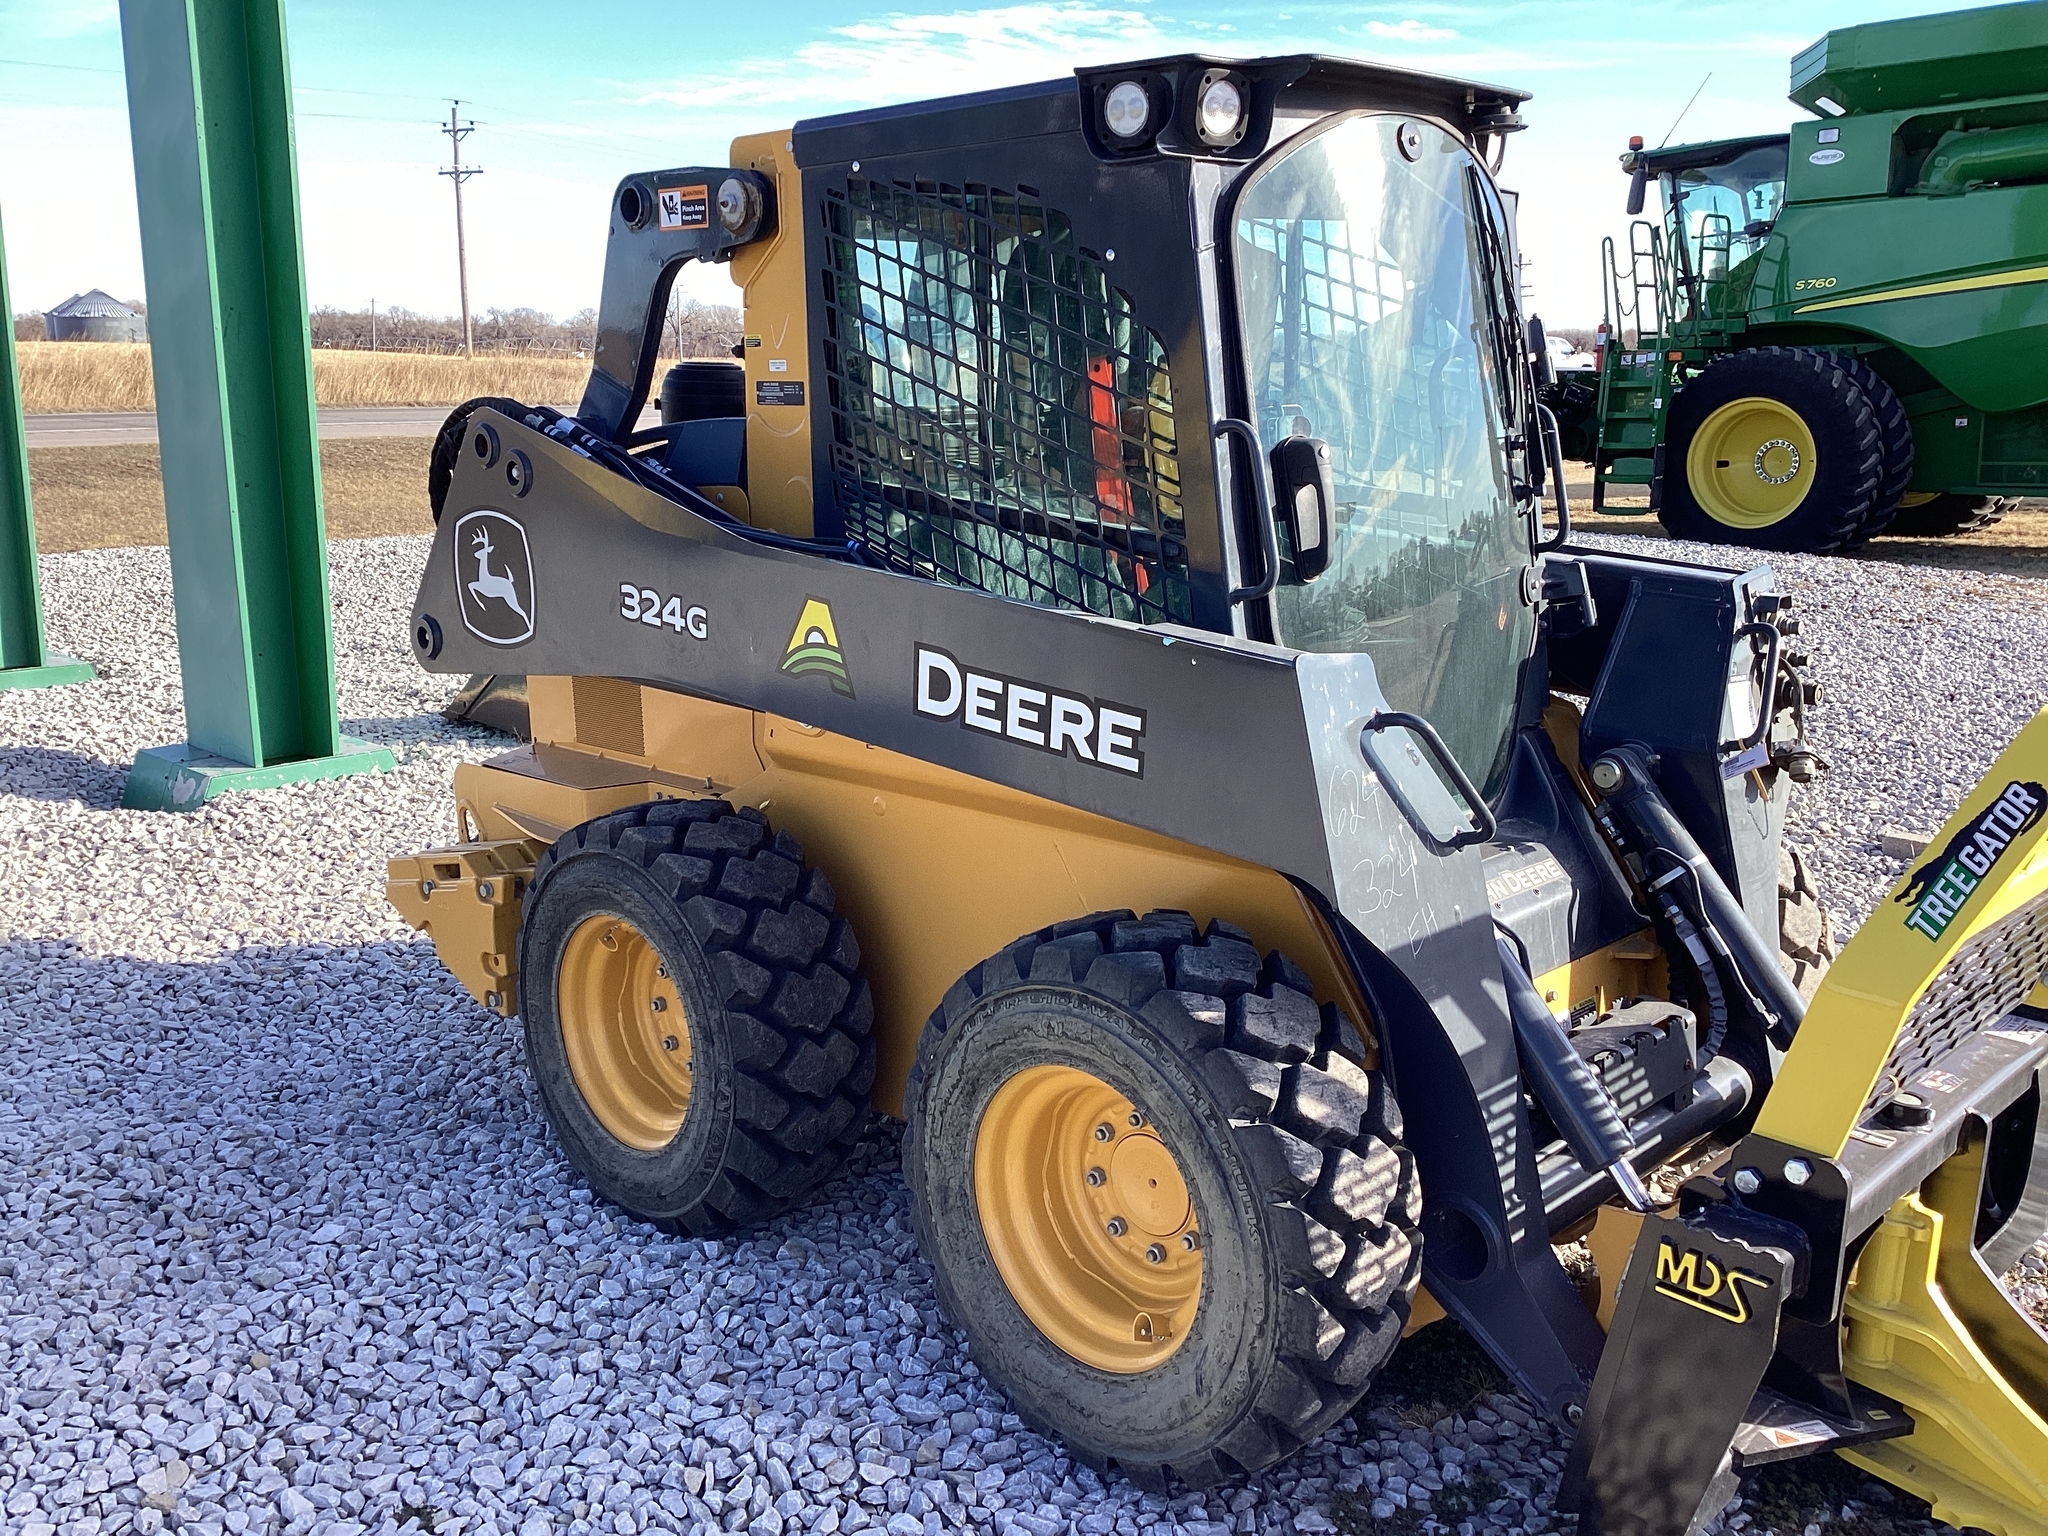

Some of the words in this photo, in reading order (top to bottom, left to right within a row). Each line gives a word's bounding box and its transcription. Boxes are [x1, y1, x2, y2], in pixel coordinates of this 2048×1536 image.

[620, 584, 707, 639] 324G
[917, 648, 1142, 773] DEERE
[1486, 879, 1509, 902] HN
[1502, 862, 1562, 893] DEERE
[1908, 863, 1978, 939] TREE
[1959, 784, 2039, 876] GATOR
[1655, 1243, 1769, 1324] MDS
